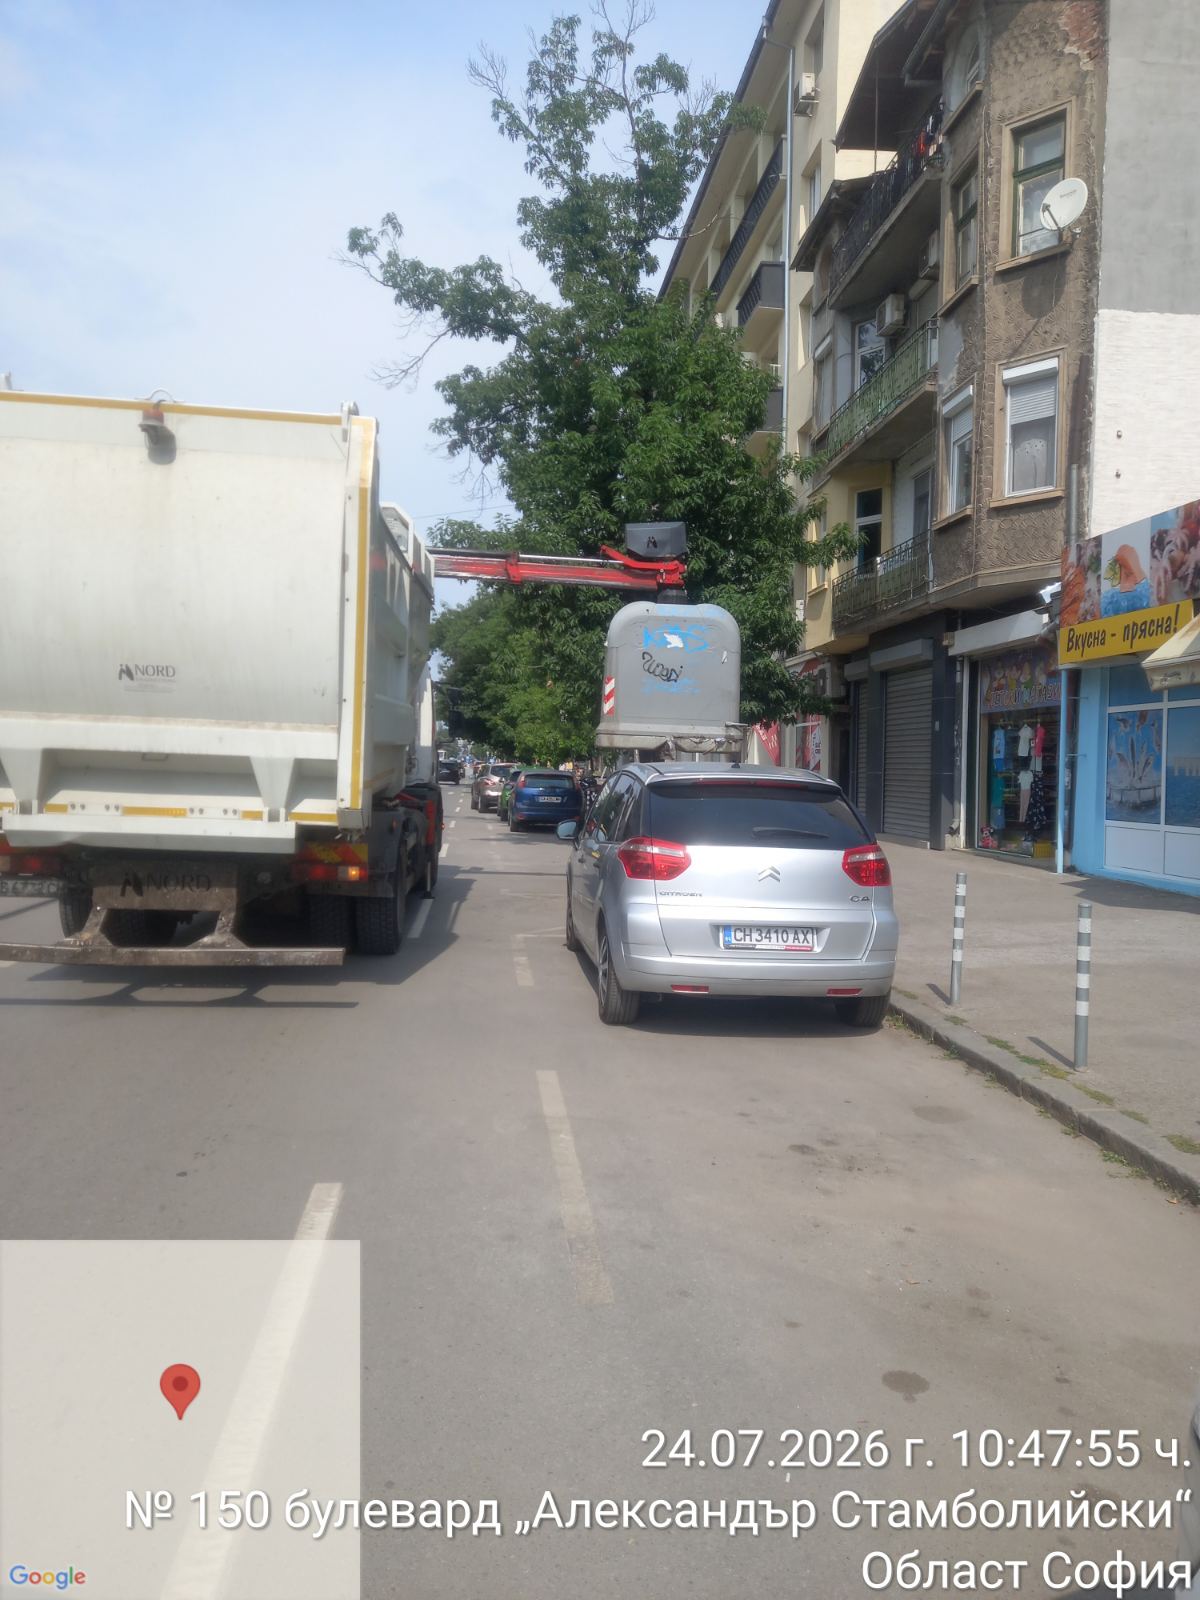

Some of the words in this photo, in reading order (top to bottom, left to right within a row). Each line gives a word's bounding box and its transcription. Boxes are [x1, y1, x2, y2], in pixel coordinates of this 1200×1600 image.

[1066, 627, 1107, 658] Вкусна
[1122, 603, 1180, 649] прясна!
[134, 663, 176, 679] NORD
[147, 873, 212, 893] NORD
[755, 928, 789, 943] 3410
